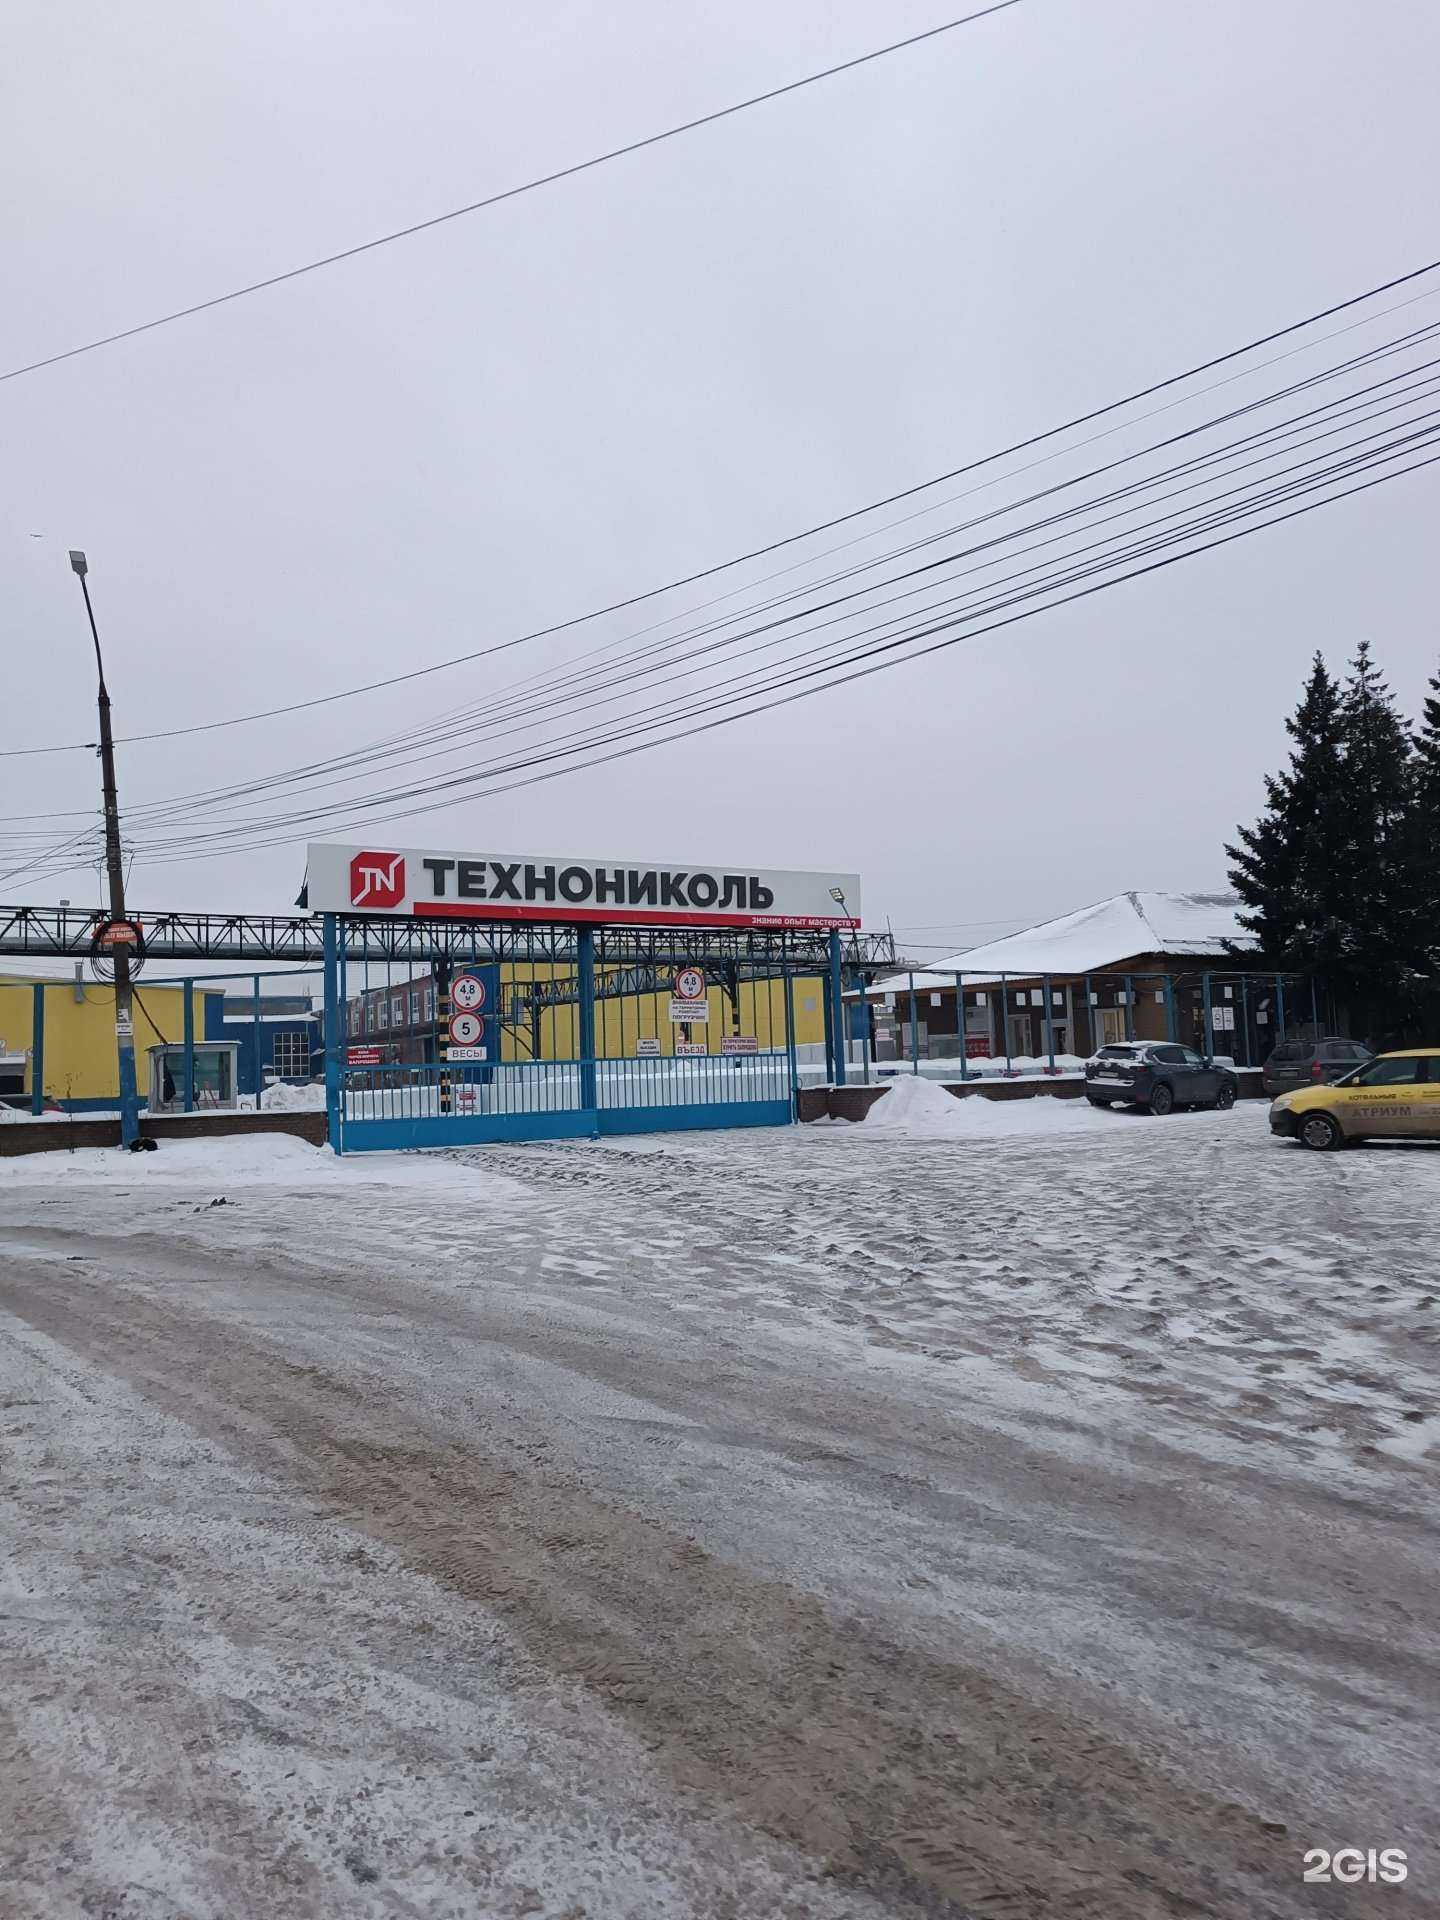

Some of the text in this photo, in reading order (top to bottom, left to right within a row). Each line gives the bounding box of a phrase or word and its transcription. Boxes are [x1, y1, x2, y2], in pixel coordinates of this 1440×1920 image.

[423, 858, 774, 909] ТЕХНОНИКОЛЬ
[752, 916, 782, 925] знание
[784, 918, 807, 927] опыт
[683, 976, 697, 986] 4,8
[460, 984, 475, 995] 4,8
[462, 1022, 471, 1036] 5
[452, 1049, 483, 1058] ВЕСЫ
[677, 1046, 705, 1054] ВЪЕЗД
[1352, 1105, 1412, 1117] АТРИУМ
